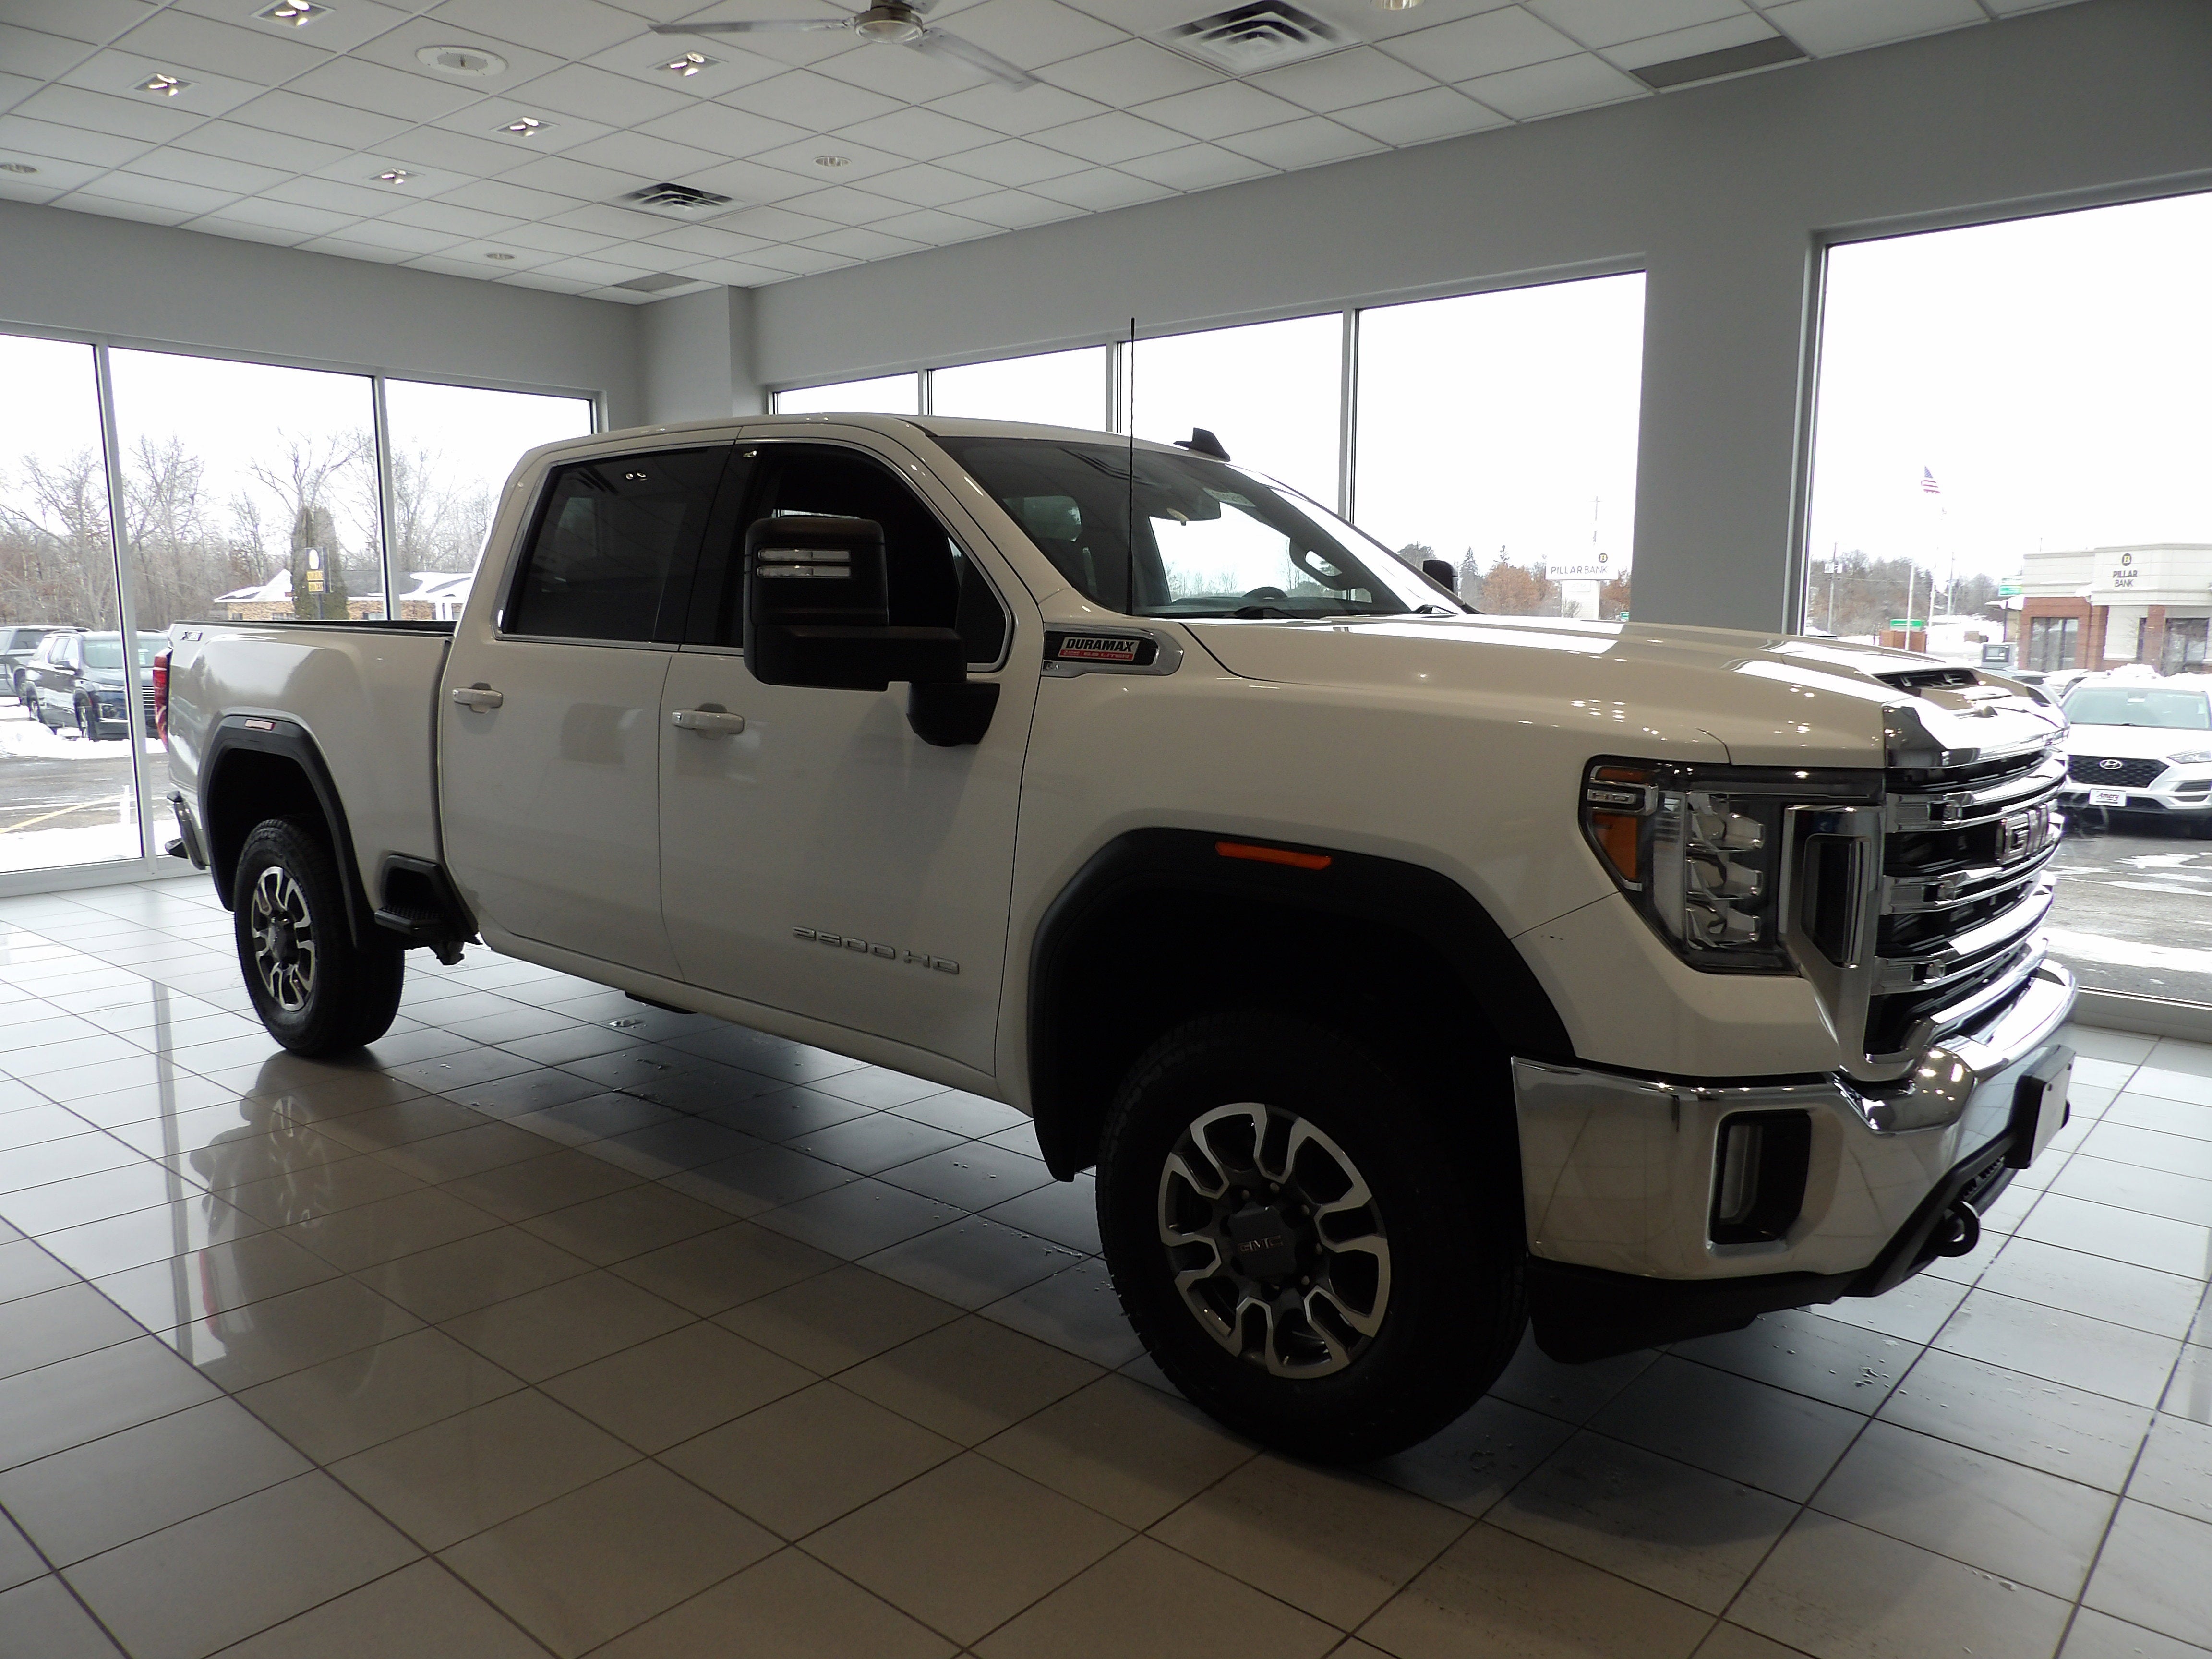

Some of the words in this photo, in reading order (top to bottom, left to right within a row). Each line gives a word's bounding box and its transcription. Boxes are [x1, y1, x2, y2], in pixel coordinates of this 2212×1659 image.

[1551, 566, 1583, 574] PILLAR
[1584, 565, 1608, 574] BANK
[2113, 570, 2138, 578] PILLAR
[2115, 579, 2134, 588] BANK
[1065, 638, 1135, 652] DURAMAX
[1238, 1235, 1284, 1253] GMC
